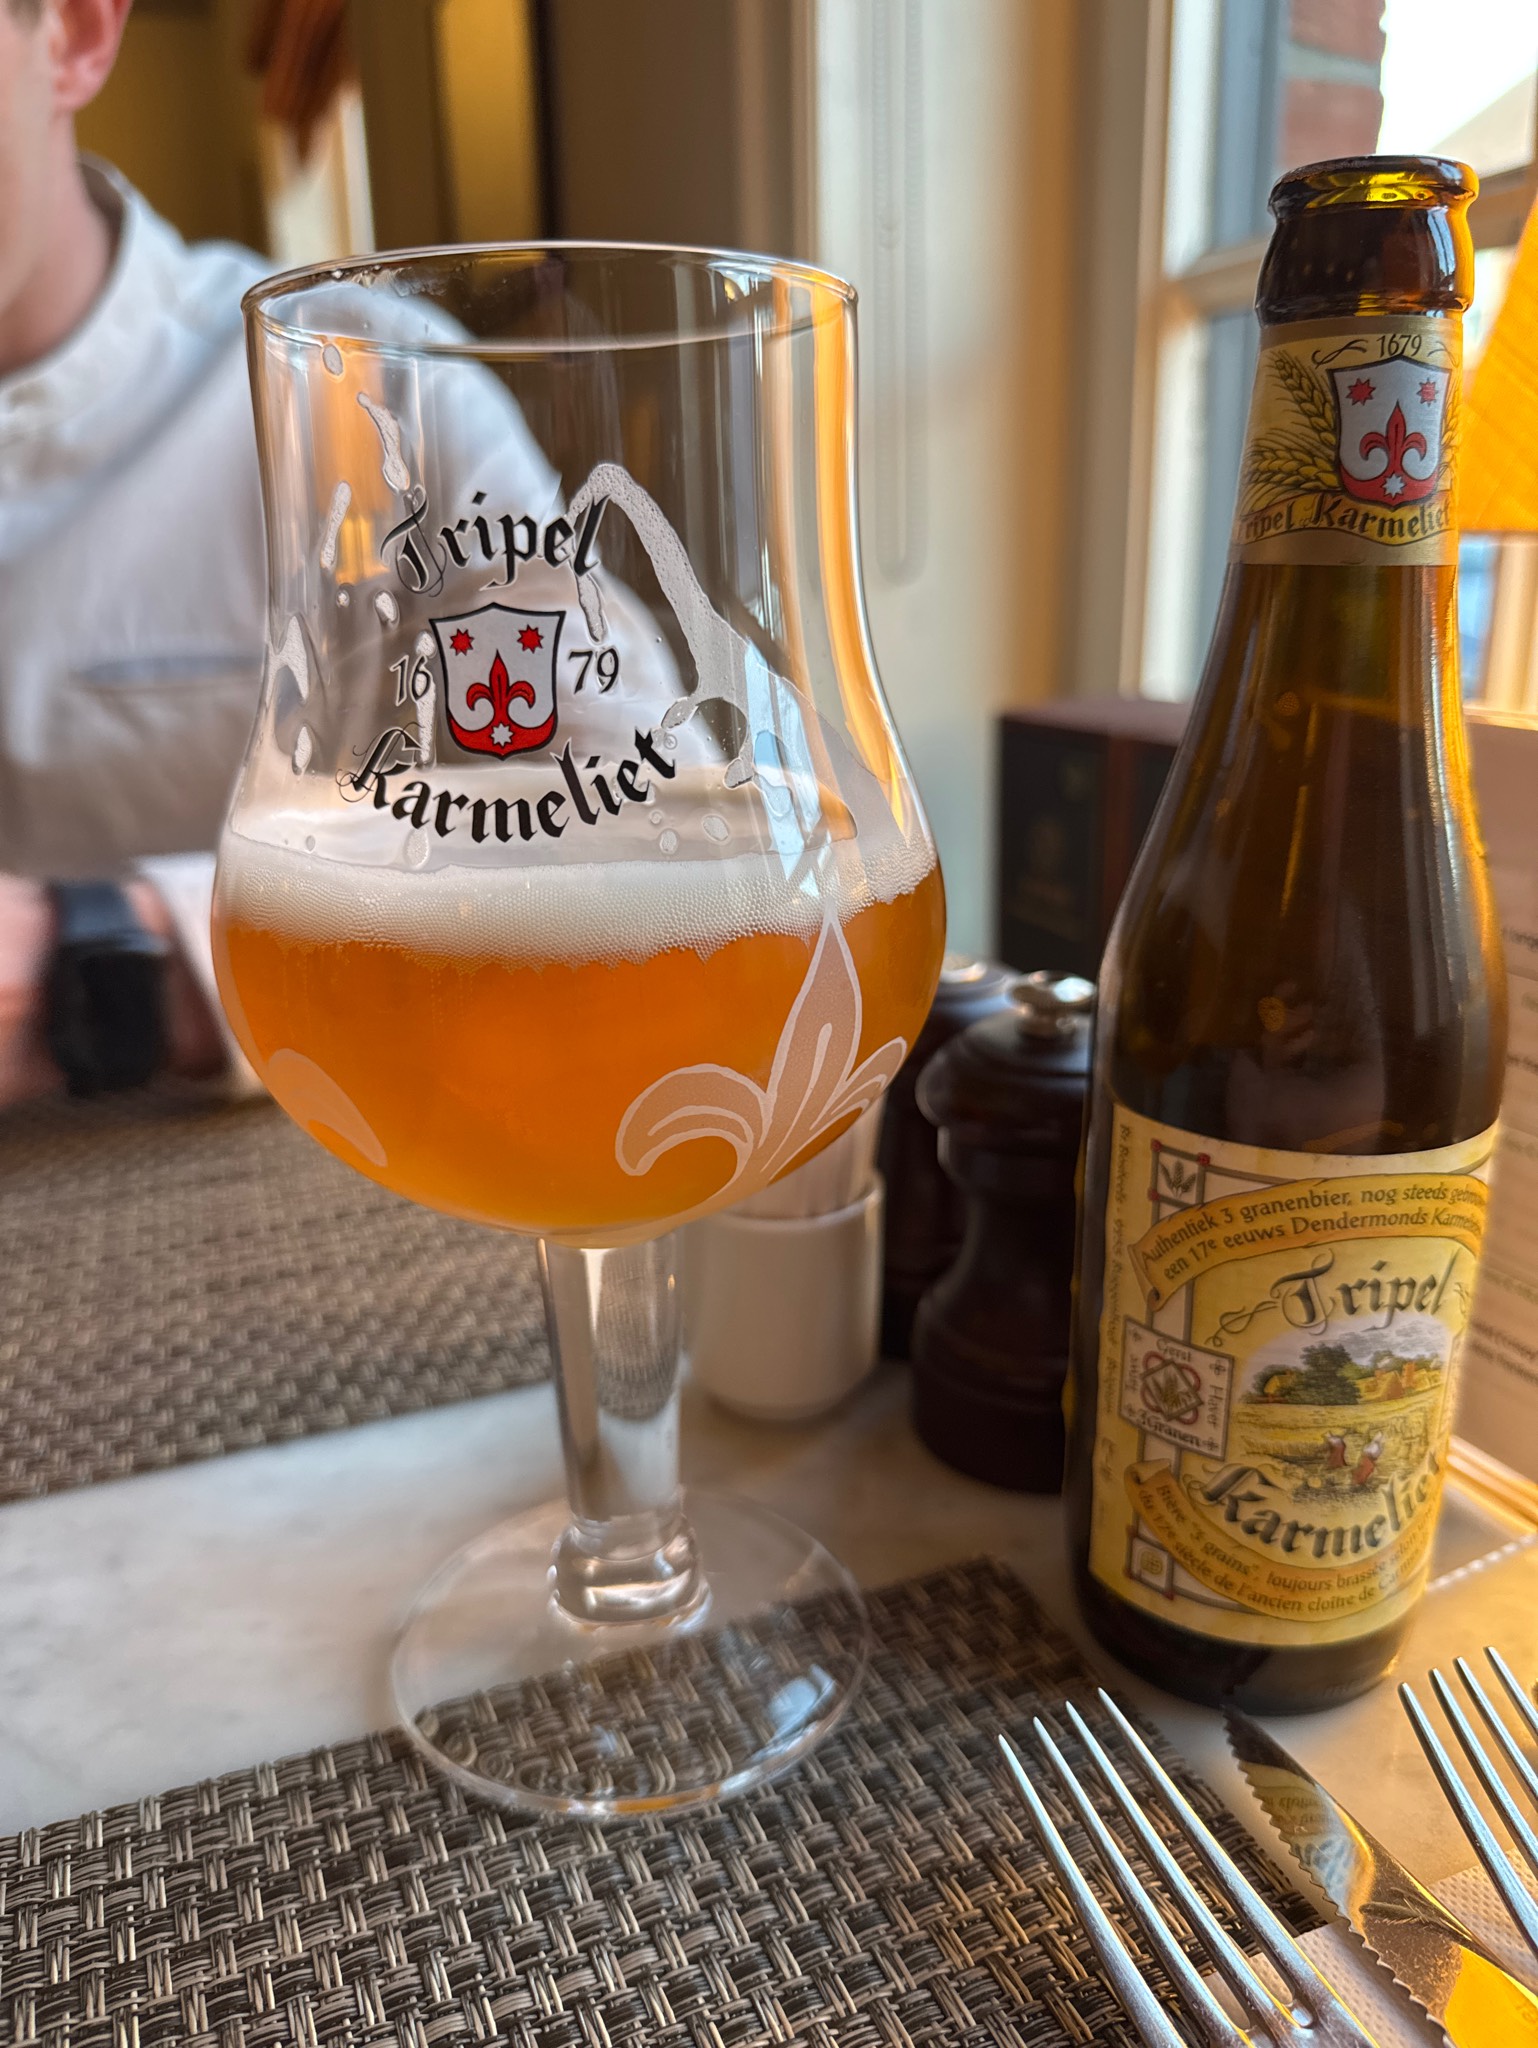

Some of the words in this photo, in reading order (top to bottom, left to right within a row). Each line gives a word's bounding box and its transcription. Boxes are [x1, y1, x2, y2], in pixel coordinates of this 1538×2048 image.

[1376, 334, 1423, 358] 1679
[380, 484, 609, 597] Tripel
[390, 654, 432, 706] 16
[569, 648, 619, 693] 79
[336, 727, 676, 843] Karmeliet
[1141, 1211, 1219, 1262] Authentiek
[1221, 1207, 1234, 1224] 3
[1239, 1188, 1353, 1223] granenbier,
[1360, 1186, 1398, 1206] nog
[1402, 1181, 1448, 1201] steeds
[1163, 1255, 1190, 1280] een
[1188, 1237, 1218, 1263] 17e
[1222, 1224, 1286, 1249] eeuws
[1291, 1207, 1429, 1236] Dendermonds
[1270, 1248, 1461, 1337] Tripel
[1205, 1383, 1226, 1430] Haver
[1174, 1541, 1213, 1577] siècle
[1213, 1571, 1235, 1591] de
[1358, 1584, 1376, 1602] de
[1266, 1571, 1333, 1594] toujours
